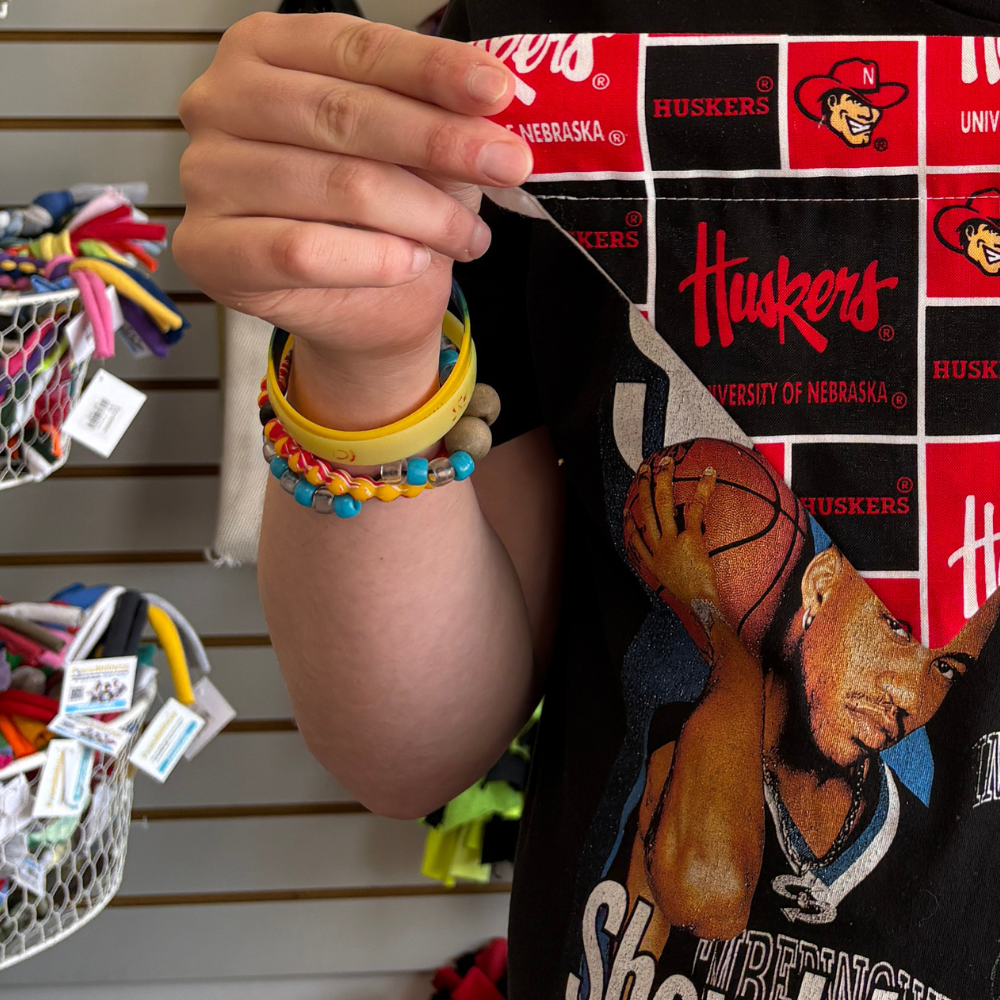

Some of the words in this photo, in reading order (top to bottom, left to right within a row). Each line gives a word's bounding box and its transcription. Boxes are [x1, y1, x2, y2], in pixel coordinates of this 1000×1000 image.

[653, 96, 770, 118] HUSKERS
[519, 120, 605, 143] NEBRASKA
[568, 231, 639, 249] KERS
[678, 221, 899, 353] Huskers
[782, 381, 803, 405] OF
[807, 380, 888, 404] NEBRASKA
